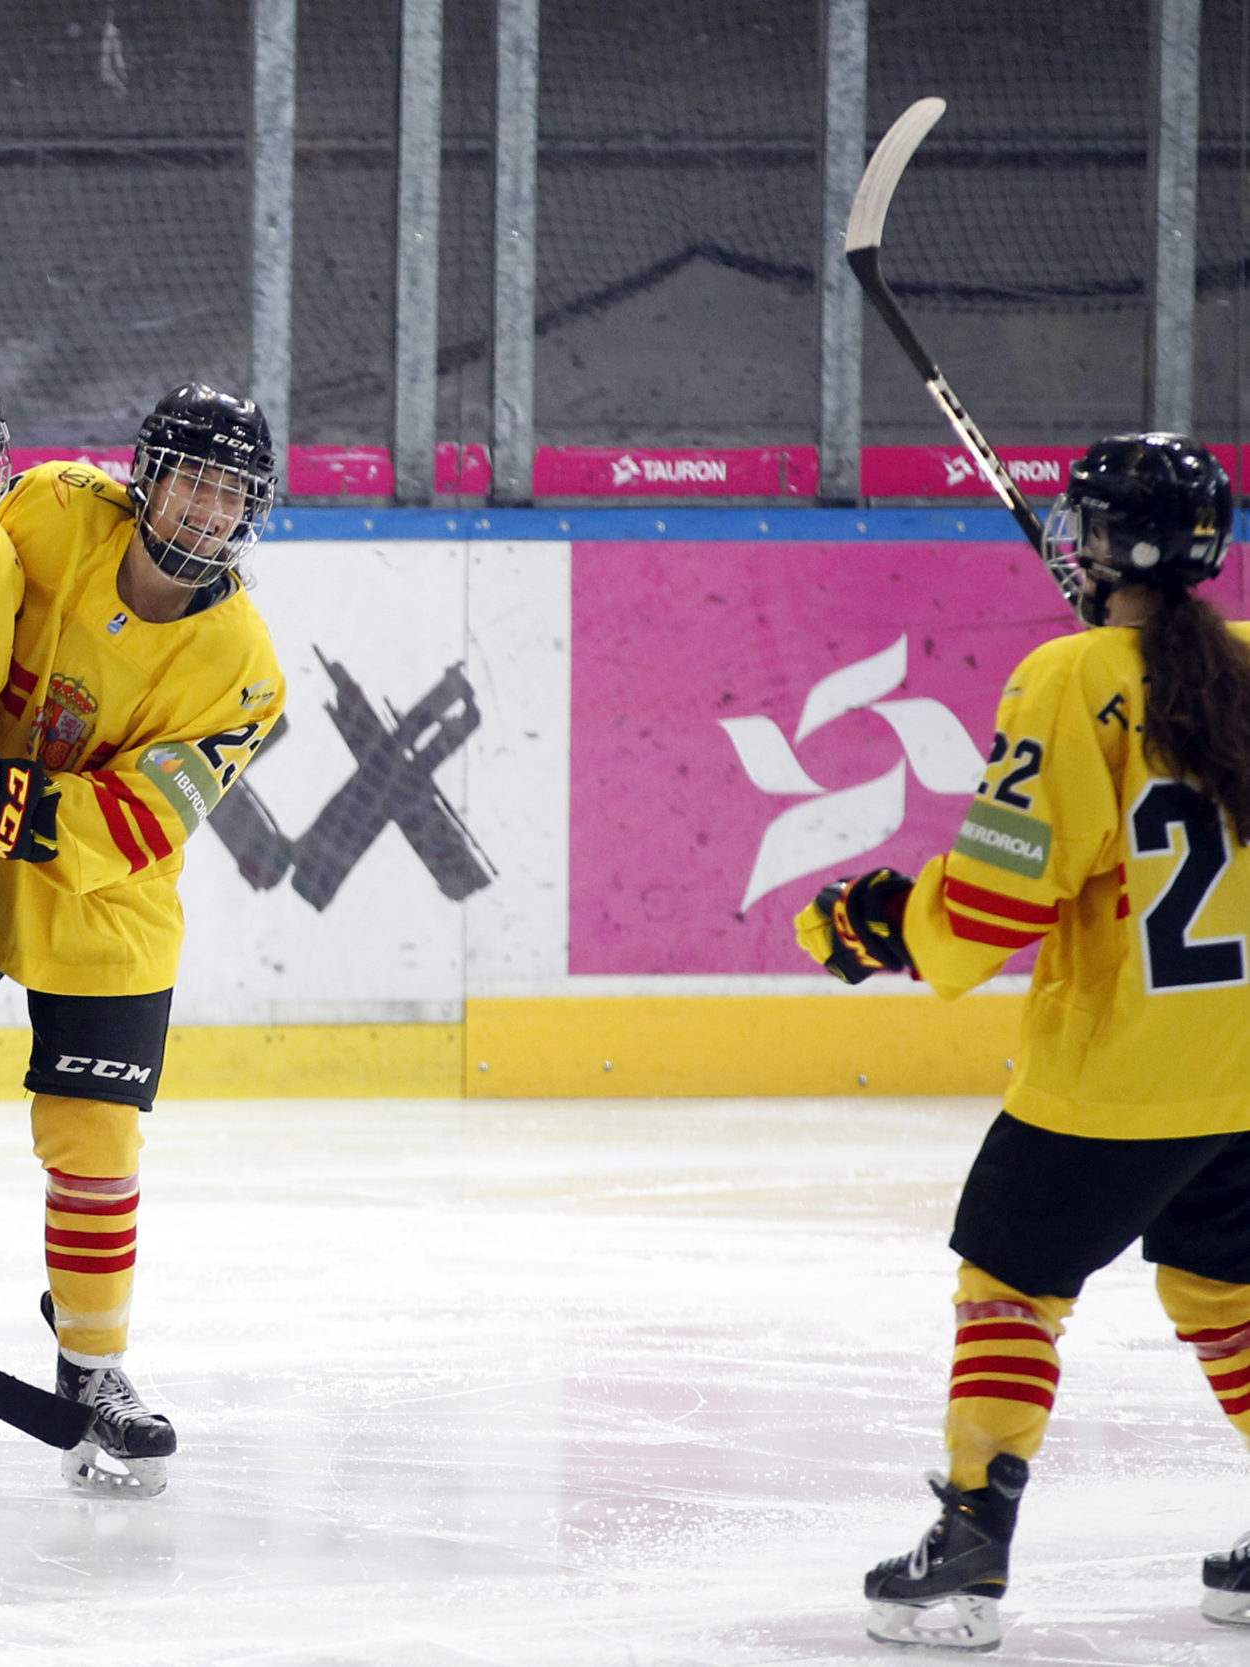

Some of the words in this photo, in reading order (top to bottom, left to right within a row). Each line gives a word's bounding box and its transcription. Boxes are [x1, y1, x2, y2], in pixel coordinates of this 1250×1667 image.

[213, 433, 255, 452] CCM
[643, 460, 726, 481] TAURON
[1129, 777, 1250, 995] 2
[55, 1055, 152, 1084] CCM
